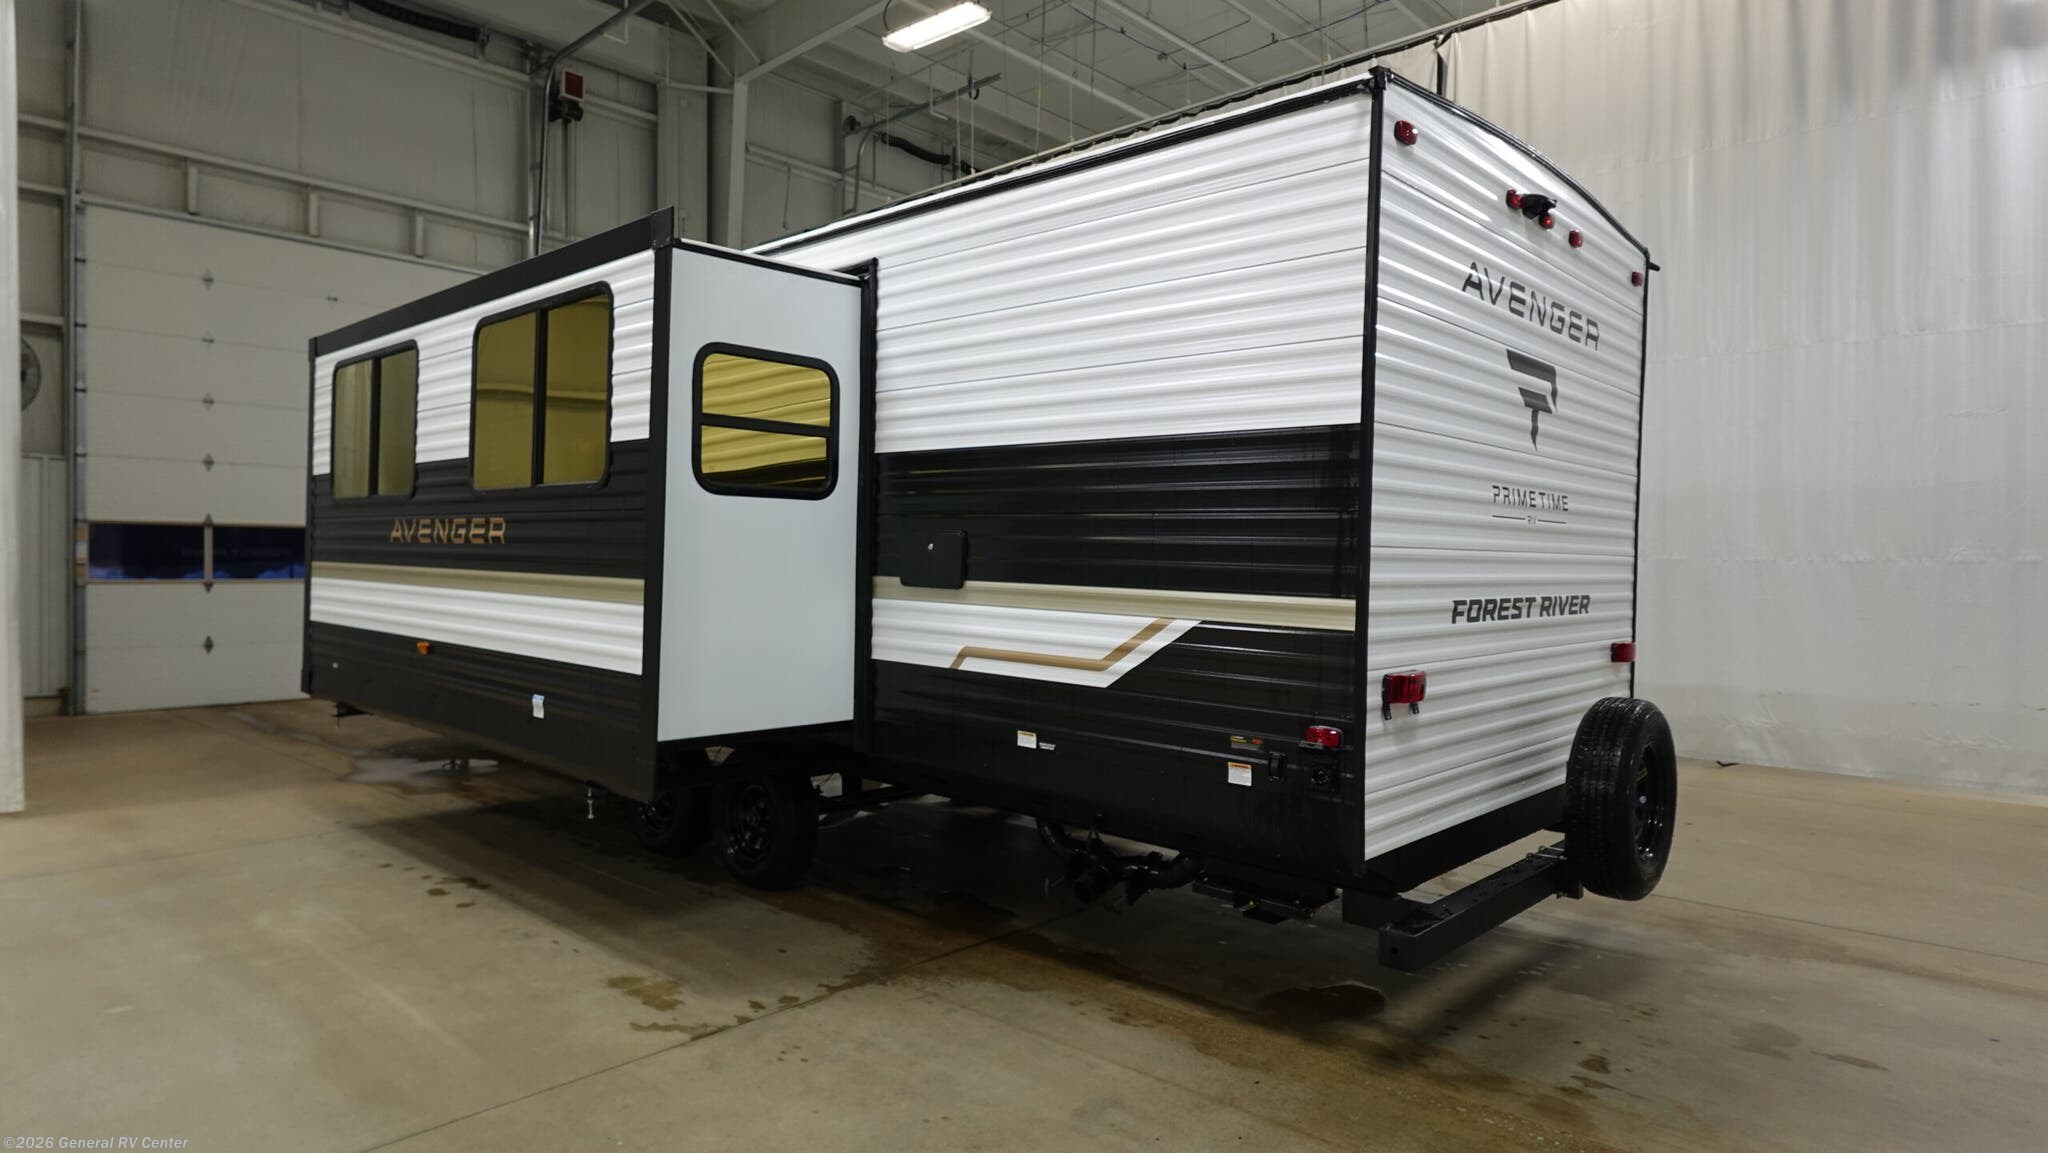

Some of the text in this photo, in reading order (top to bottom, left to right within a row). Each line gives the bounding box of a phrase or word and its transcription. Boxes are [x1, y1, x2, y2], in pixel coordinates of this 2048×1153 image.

[1462, 261, 1600, 351] AVENGER
[390, 517, 506, 545] AVENGER
[1451, 595, 1591, 625] FOREST RIVER
